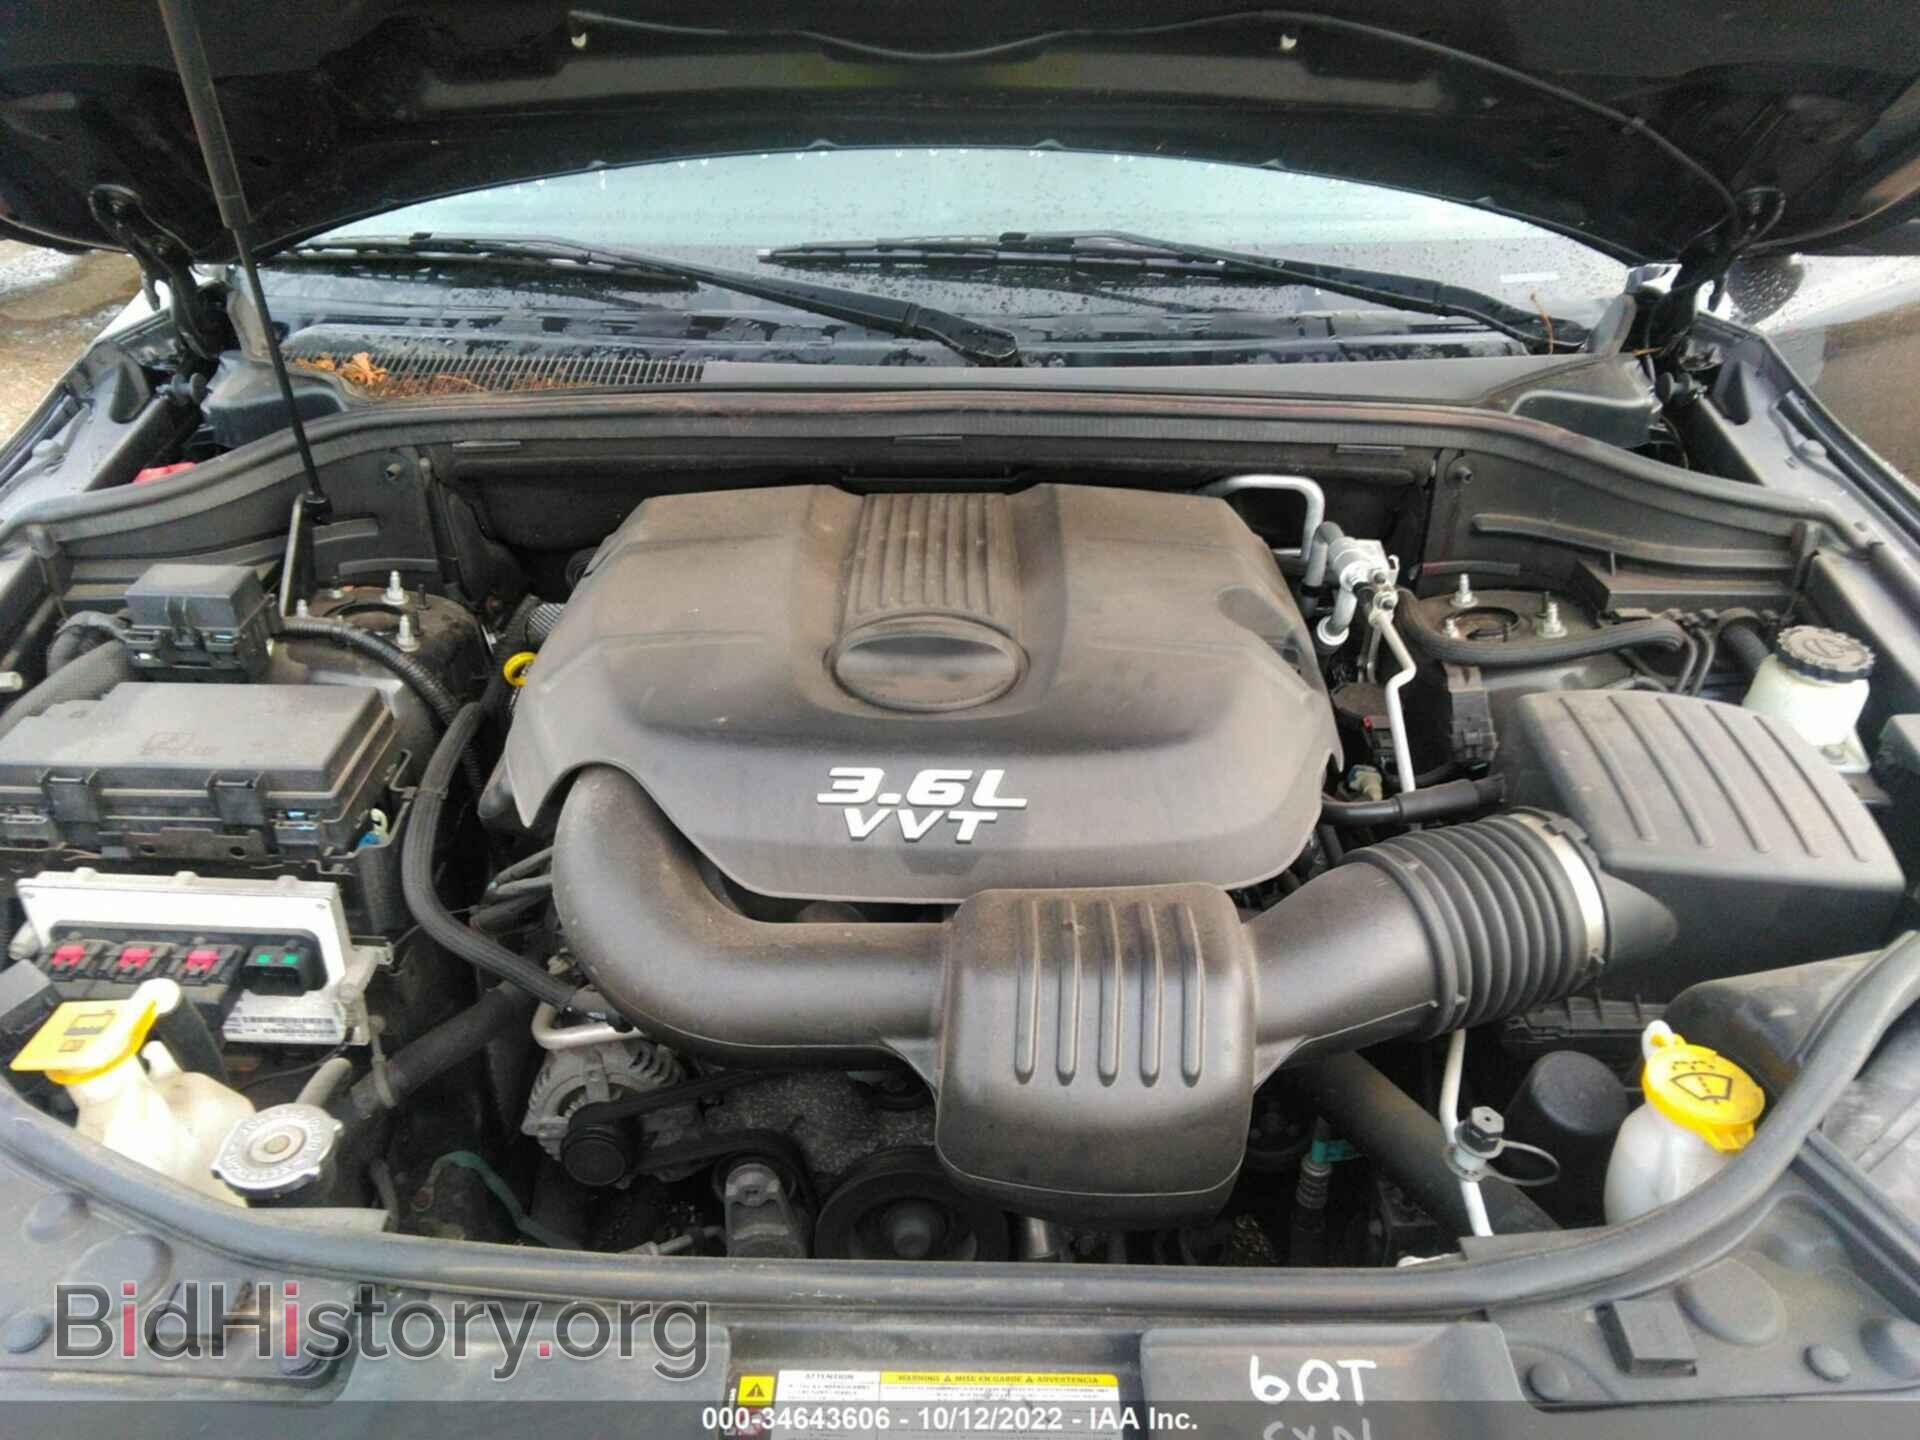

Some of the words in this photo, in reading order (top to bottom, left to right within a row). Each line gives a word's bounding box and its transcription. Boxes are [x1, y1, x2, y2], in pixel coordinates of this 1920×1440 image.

[816, 767, 1028, 808] 3.6L
[844, 808, 998, 843] VVT
[1250, 1354, 1377, 1406] 6QT
